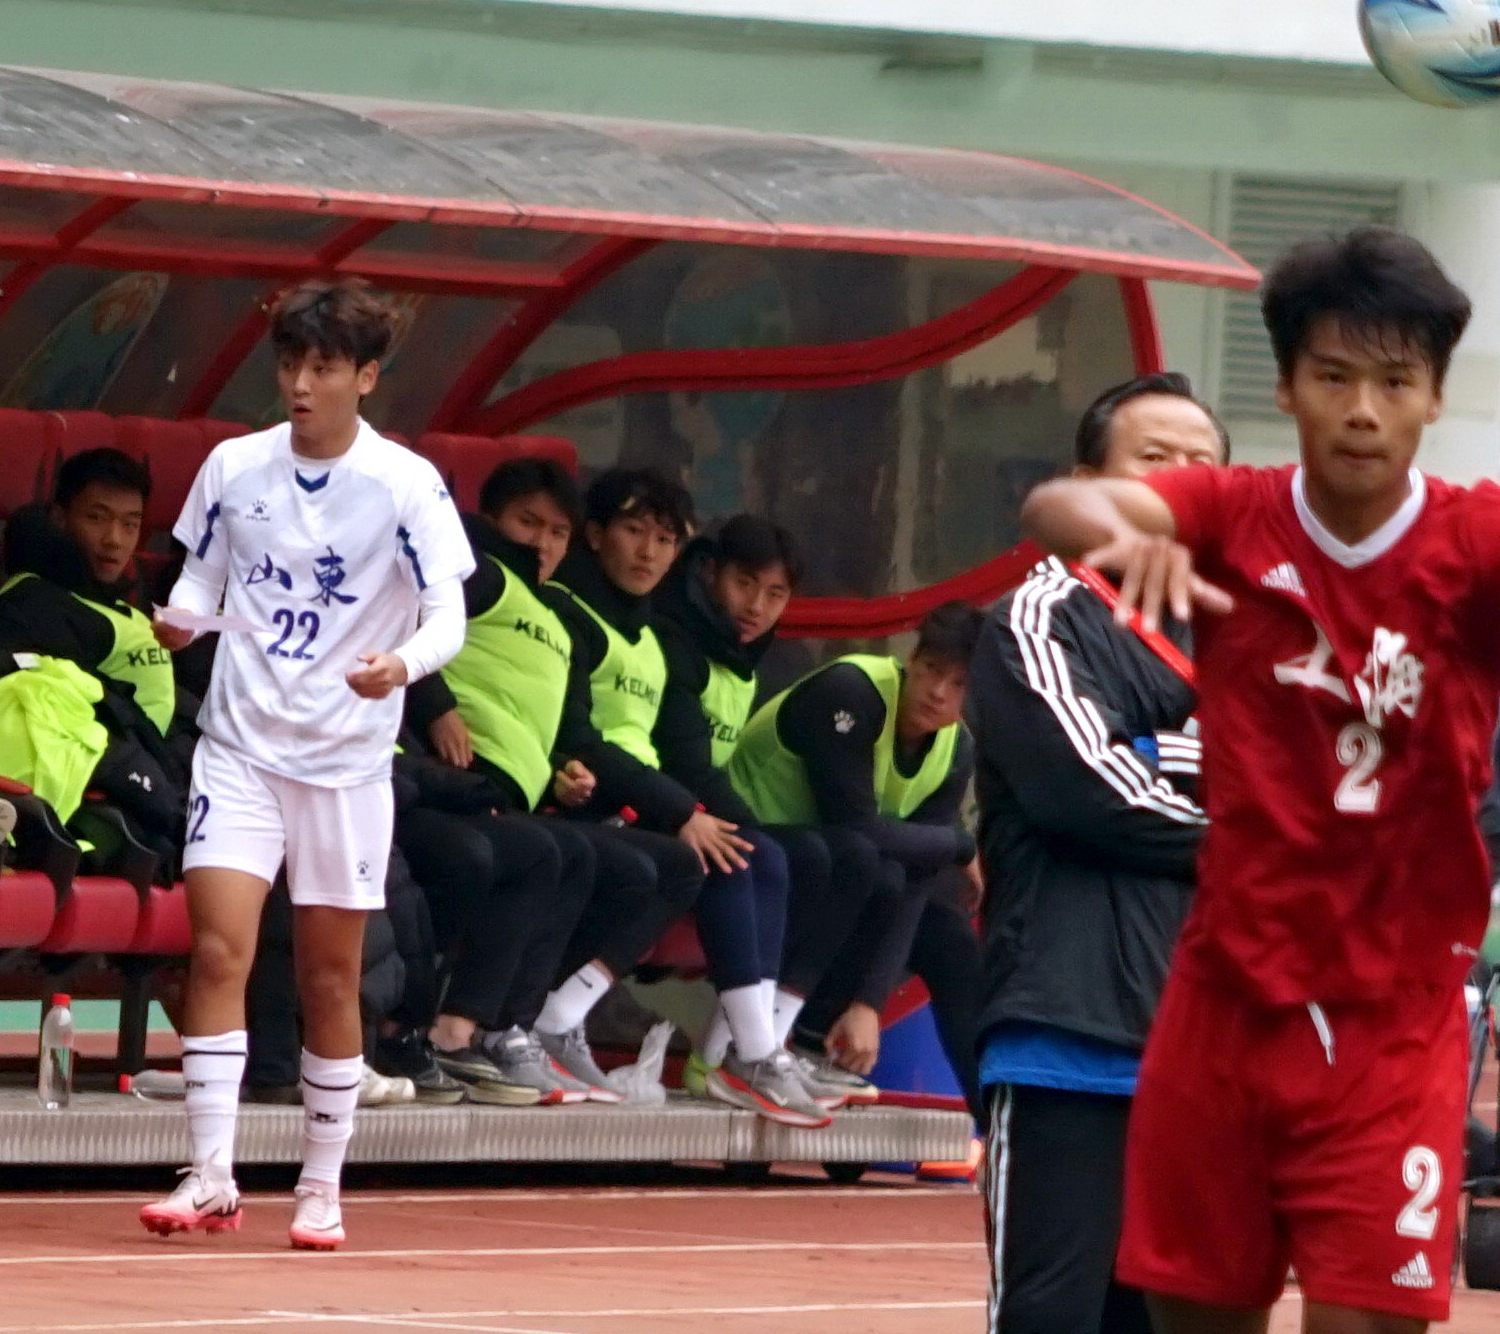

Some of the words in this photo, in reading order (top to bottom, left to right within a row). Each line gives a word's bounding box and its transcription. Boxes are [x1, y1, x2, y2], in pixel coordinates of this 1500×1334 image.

[266, 608, 321, 660] 22
[1334, 721, 1382, 813] 2
[187, 794, 211, 844] 2
[1395, 1144, 1442, 1240] 2
